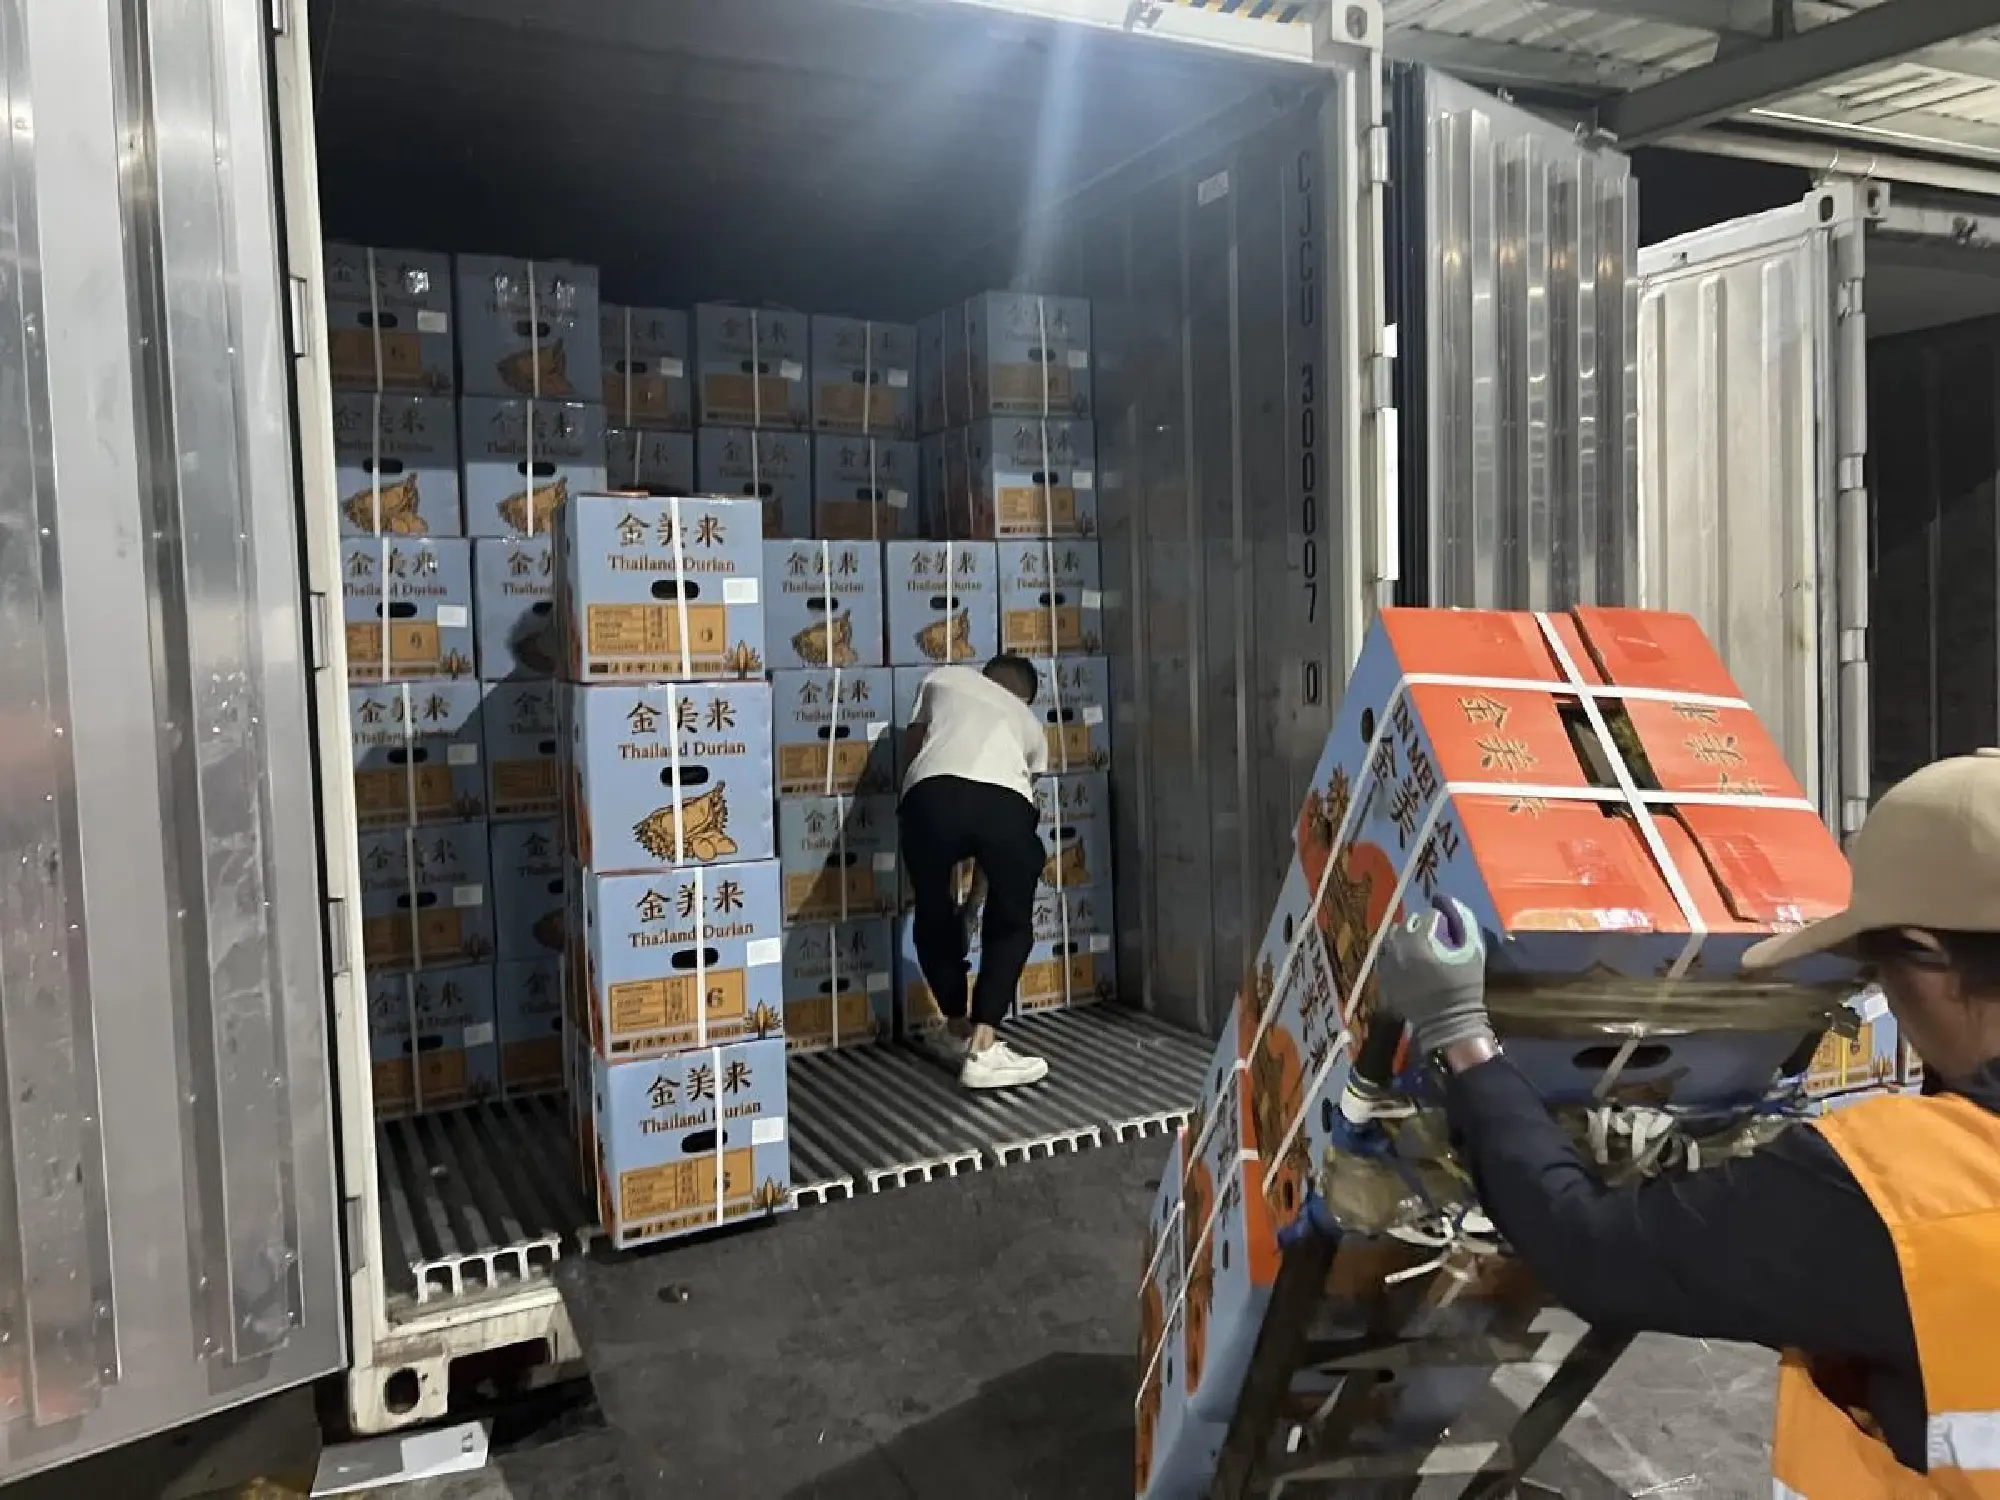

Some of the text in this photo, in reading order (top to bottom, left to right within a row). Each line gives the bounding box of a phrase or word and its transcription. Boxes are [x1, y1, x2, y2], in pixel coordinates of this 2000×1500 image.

[1302, 364, 1317, 623] 300007
[1306, 662, 1319, 705] 0
[617, 739, 746, 760] Thailad Durian
[628, 925, 697, 948] Thailand
[646, 1060, 753, 1109] 金美来
[639, 1107, 706, 1135] Thailand
